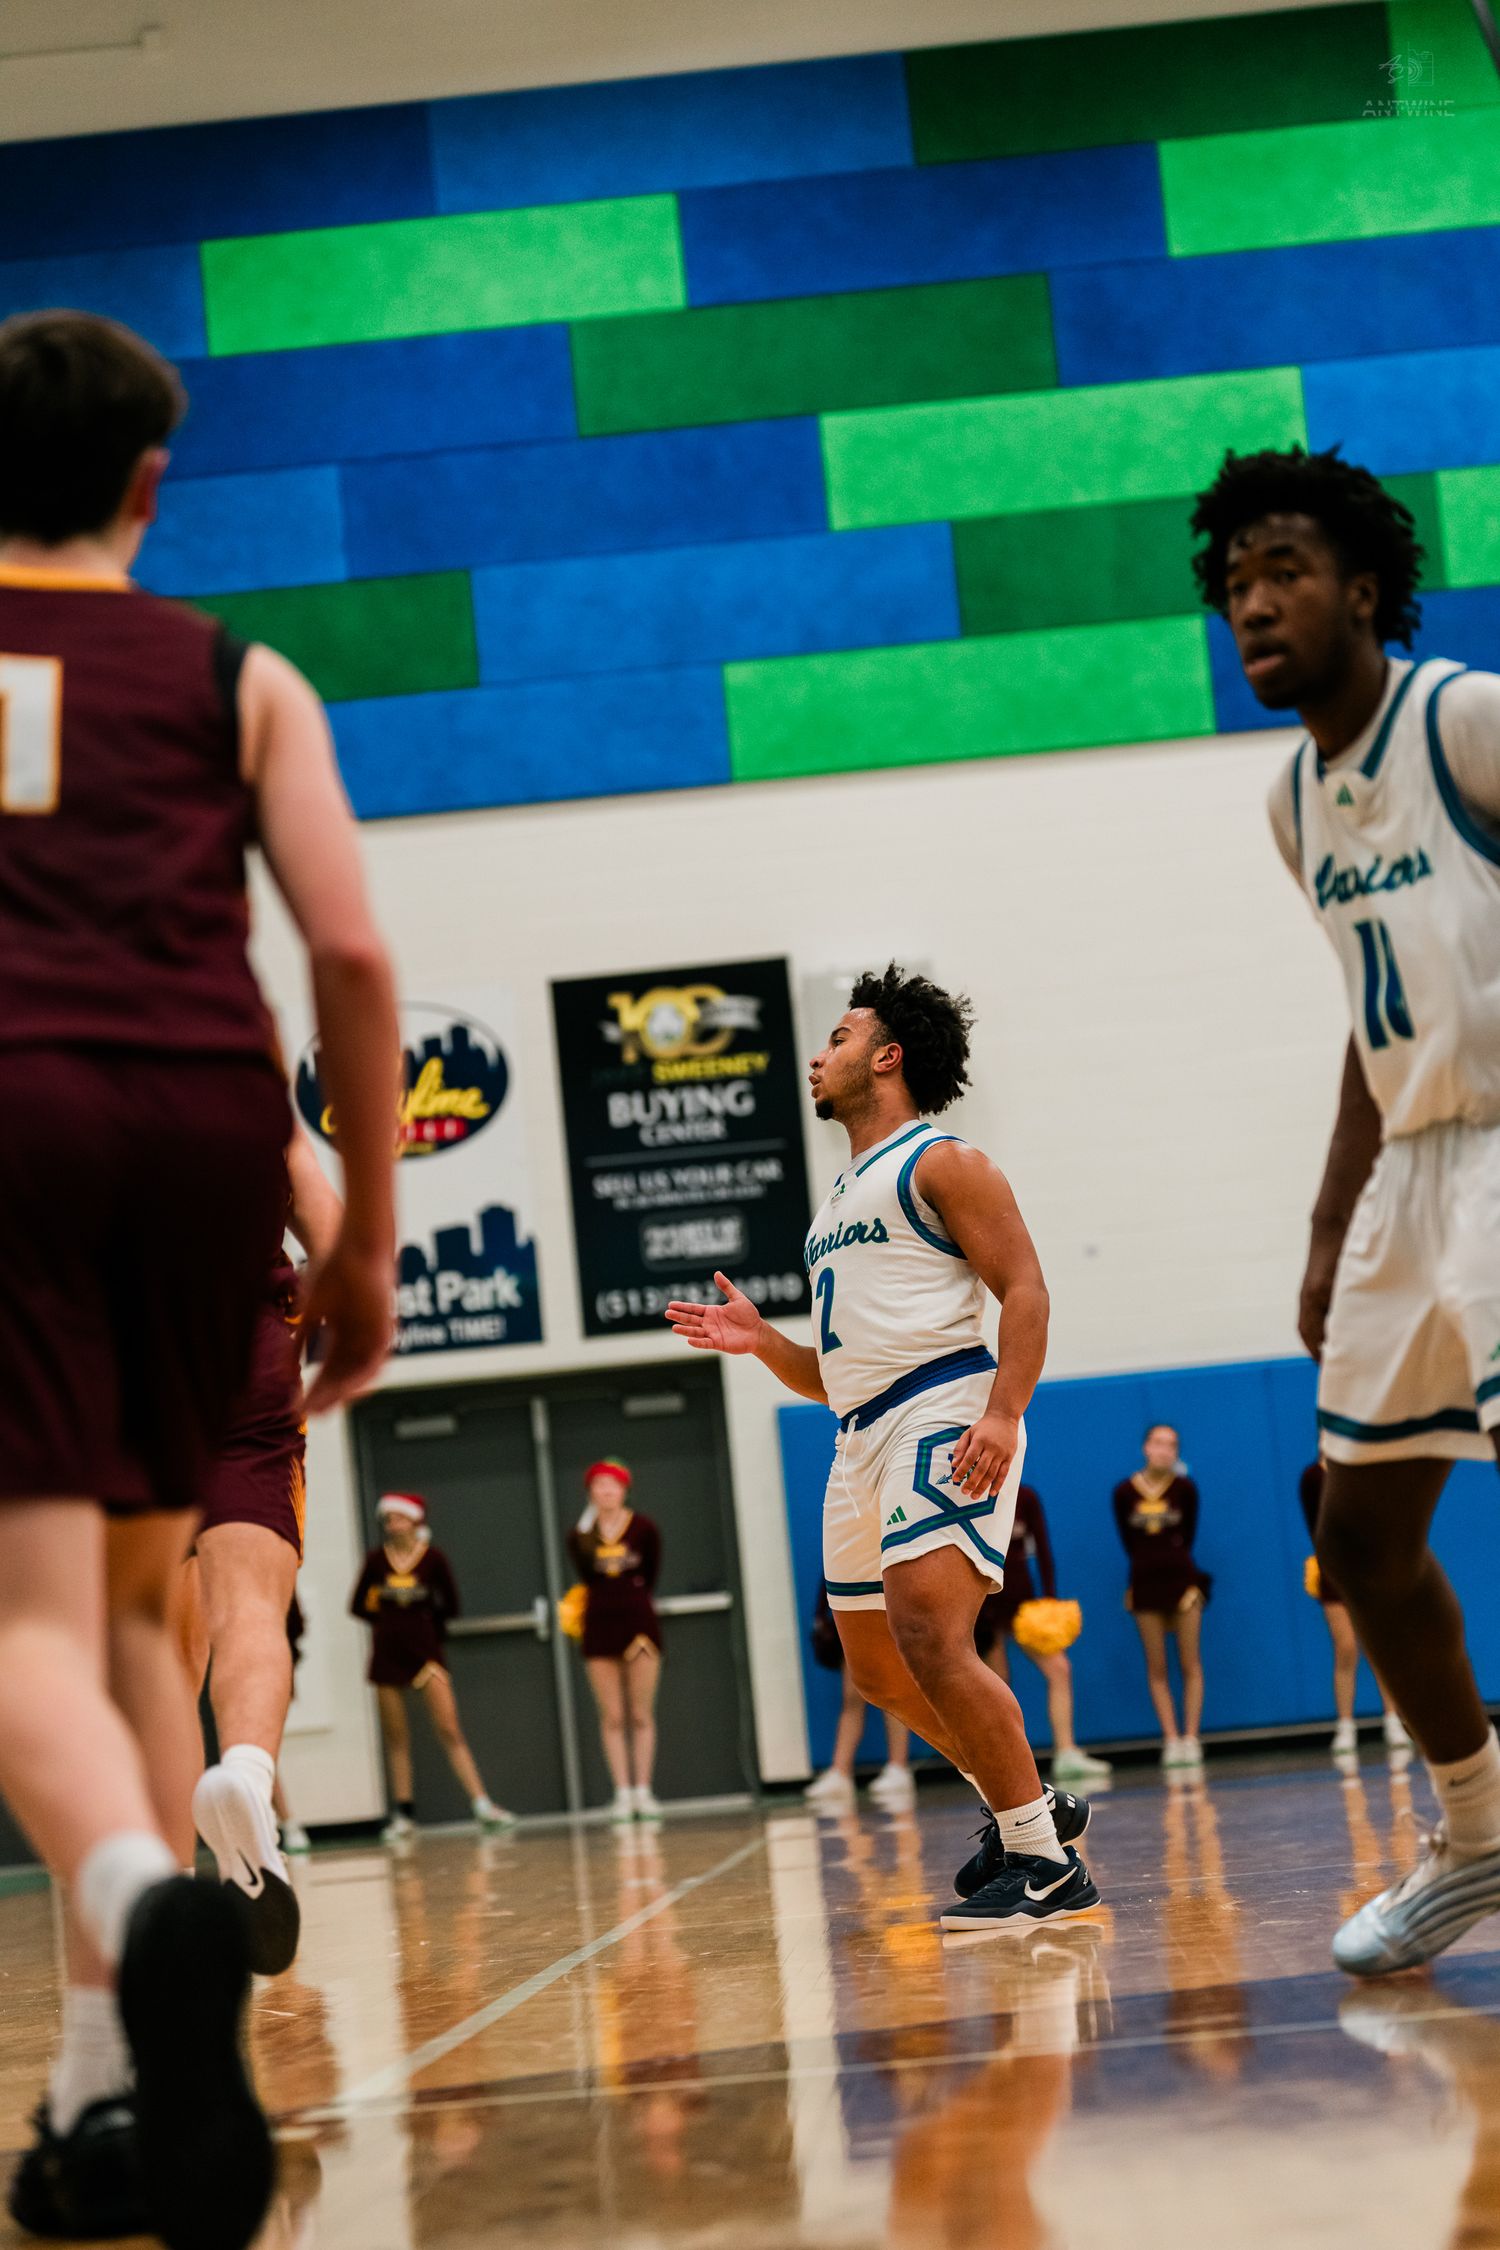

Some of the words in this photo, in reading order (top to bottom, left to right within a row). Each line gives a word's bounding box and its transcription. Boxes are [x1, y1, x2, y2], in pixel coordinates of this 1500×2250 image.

[652, 1052, 769, 1083] SWEENEY
[607, 1079, 756, 1129] BUYING
[639, 1119, 727, 1147] CENTER
[639, 1169, 670, 1195] US
[671, 1162, 734, 1190] YOUR
[735, 1157, 784, 1185] CAR
[434, 1267, 522, 1314] Park
[815, 1266, 843, 1356] 2
